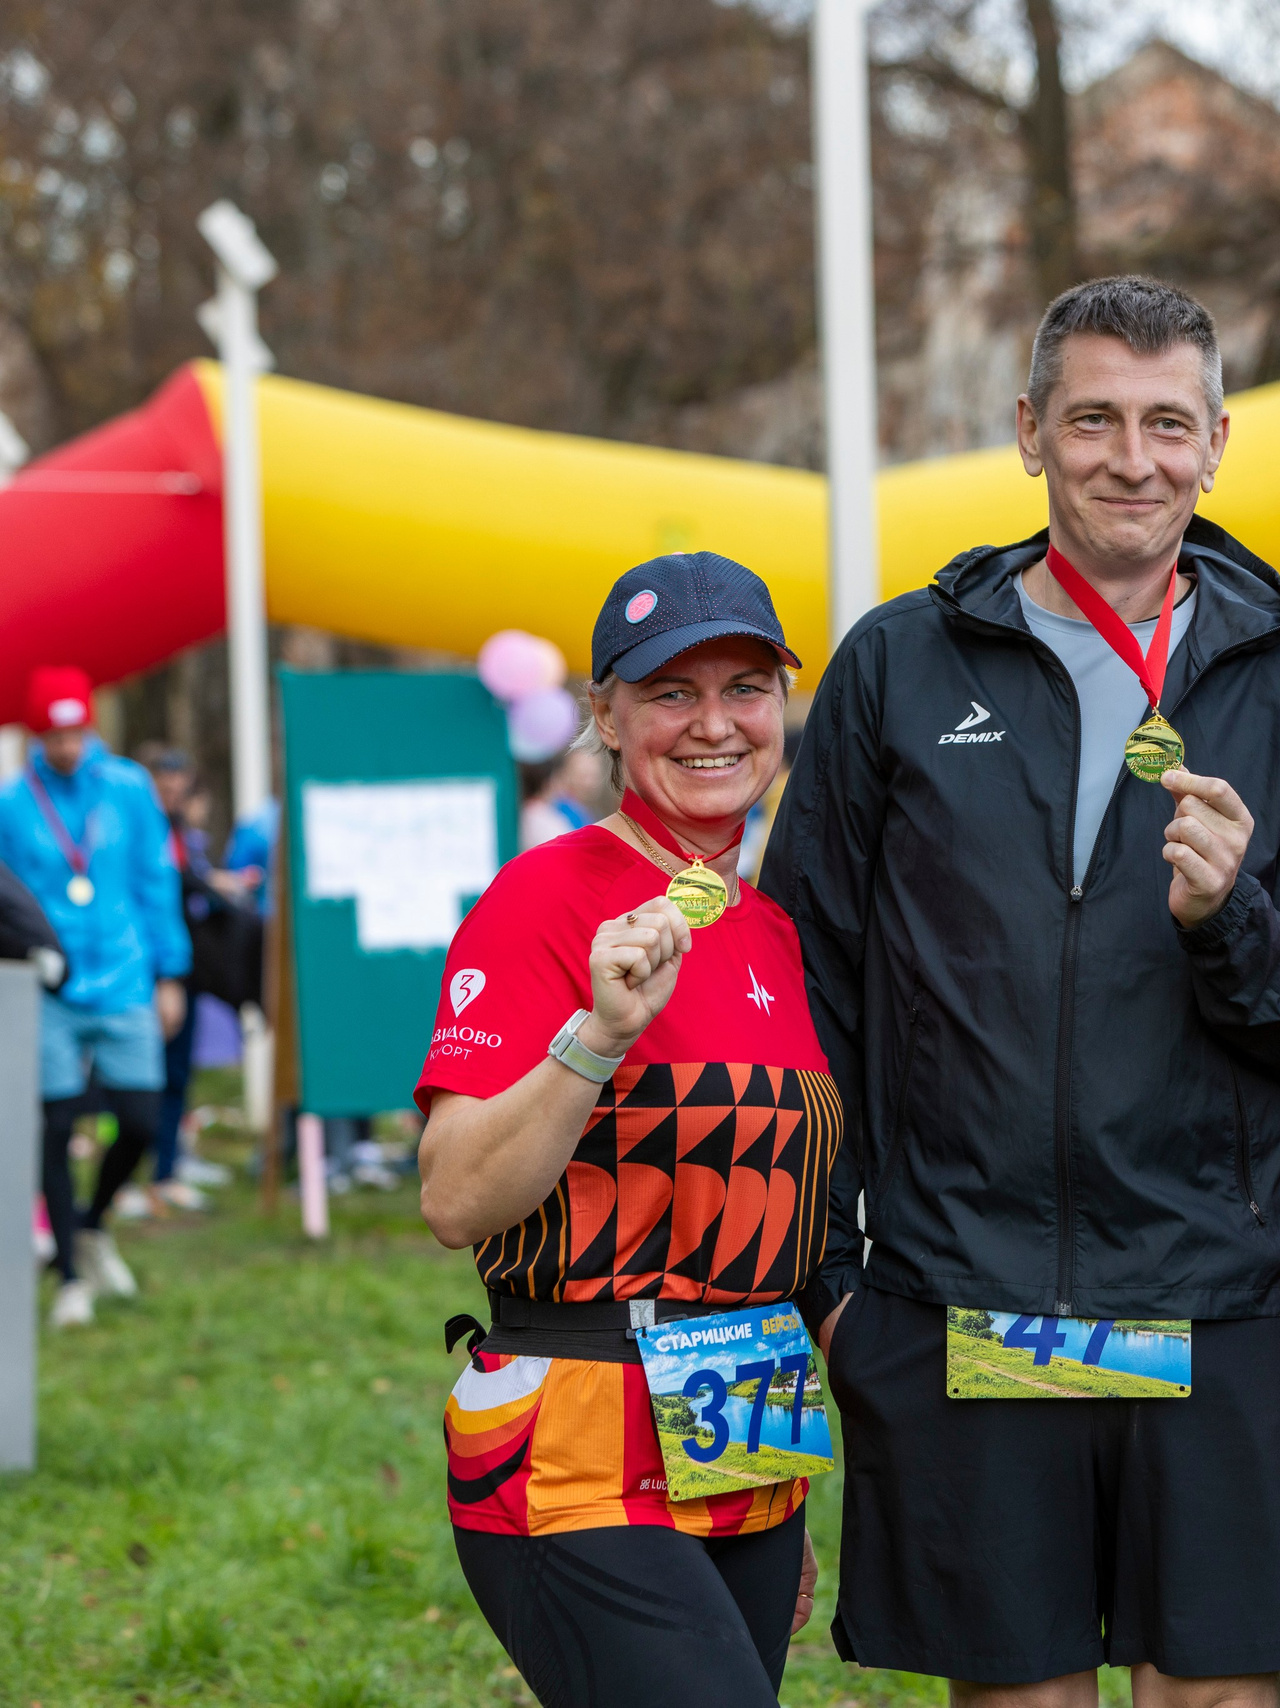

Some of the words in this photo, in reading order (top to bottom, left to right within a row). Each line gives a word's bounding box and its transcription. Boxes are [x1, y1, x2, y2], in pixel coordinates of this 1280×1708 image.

[938, 731, 1006, 745] DEMIX
[655, 1322, 753, 1353] СТАРИЦКИЕ
[681, 1352, 808, 1464] 377
[651, 1479, 668, 1490] LUC
